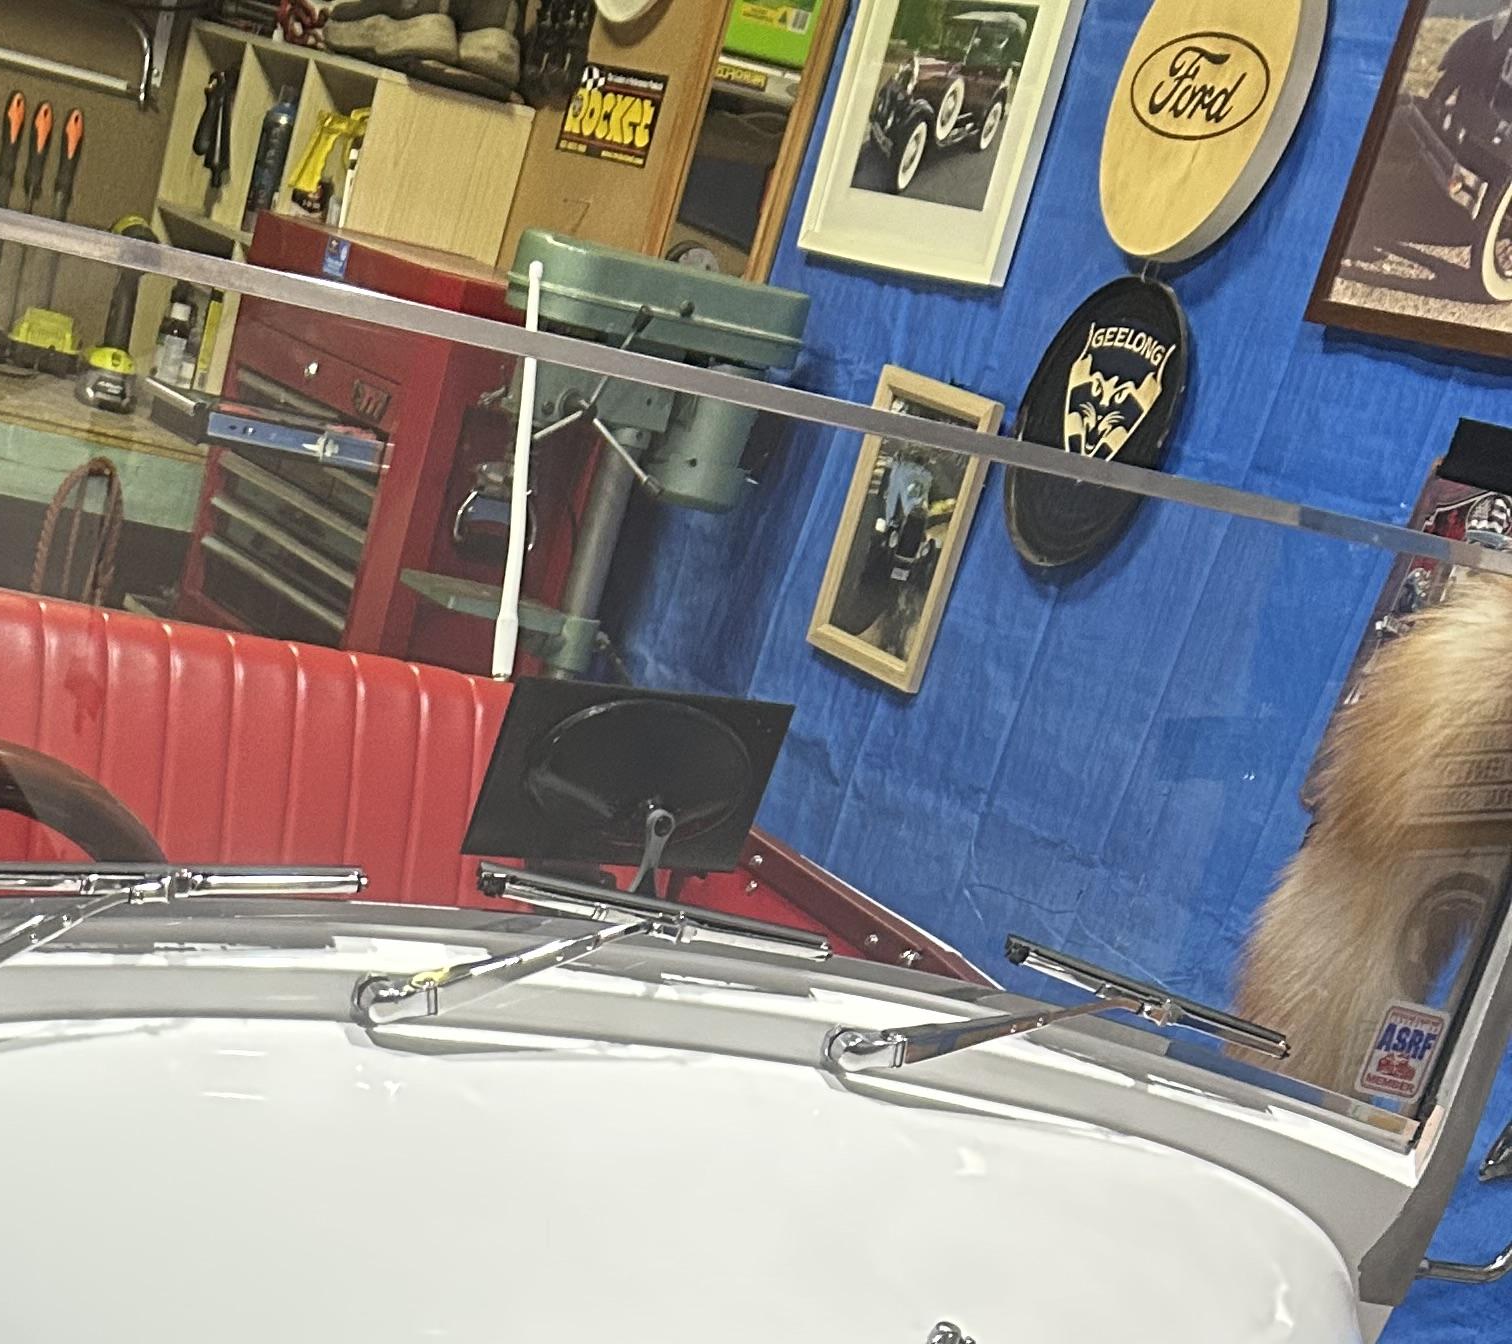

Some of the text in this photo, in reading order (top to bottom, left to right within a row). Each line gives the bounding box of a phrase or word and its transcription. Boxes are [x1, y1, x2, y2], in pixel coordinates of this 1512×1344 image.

[1148, 46, 1247, 123] Ford
[1091, 327, 1165, 366] GEELONG
[1376, 1023, 1438, 1061] ASRF
[1366, 1072, 1415, 1093] MEMBER
